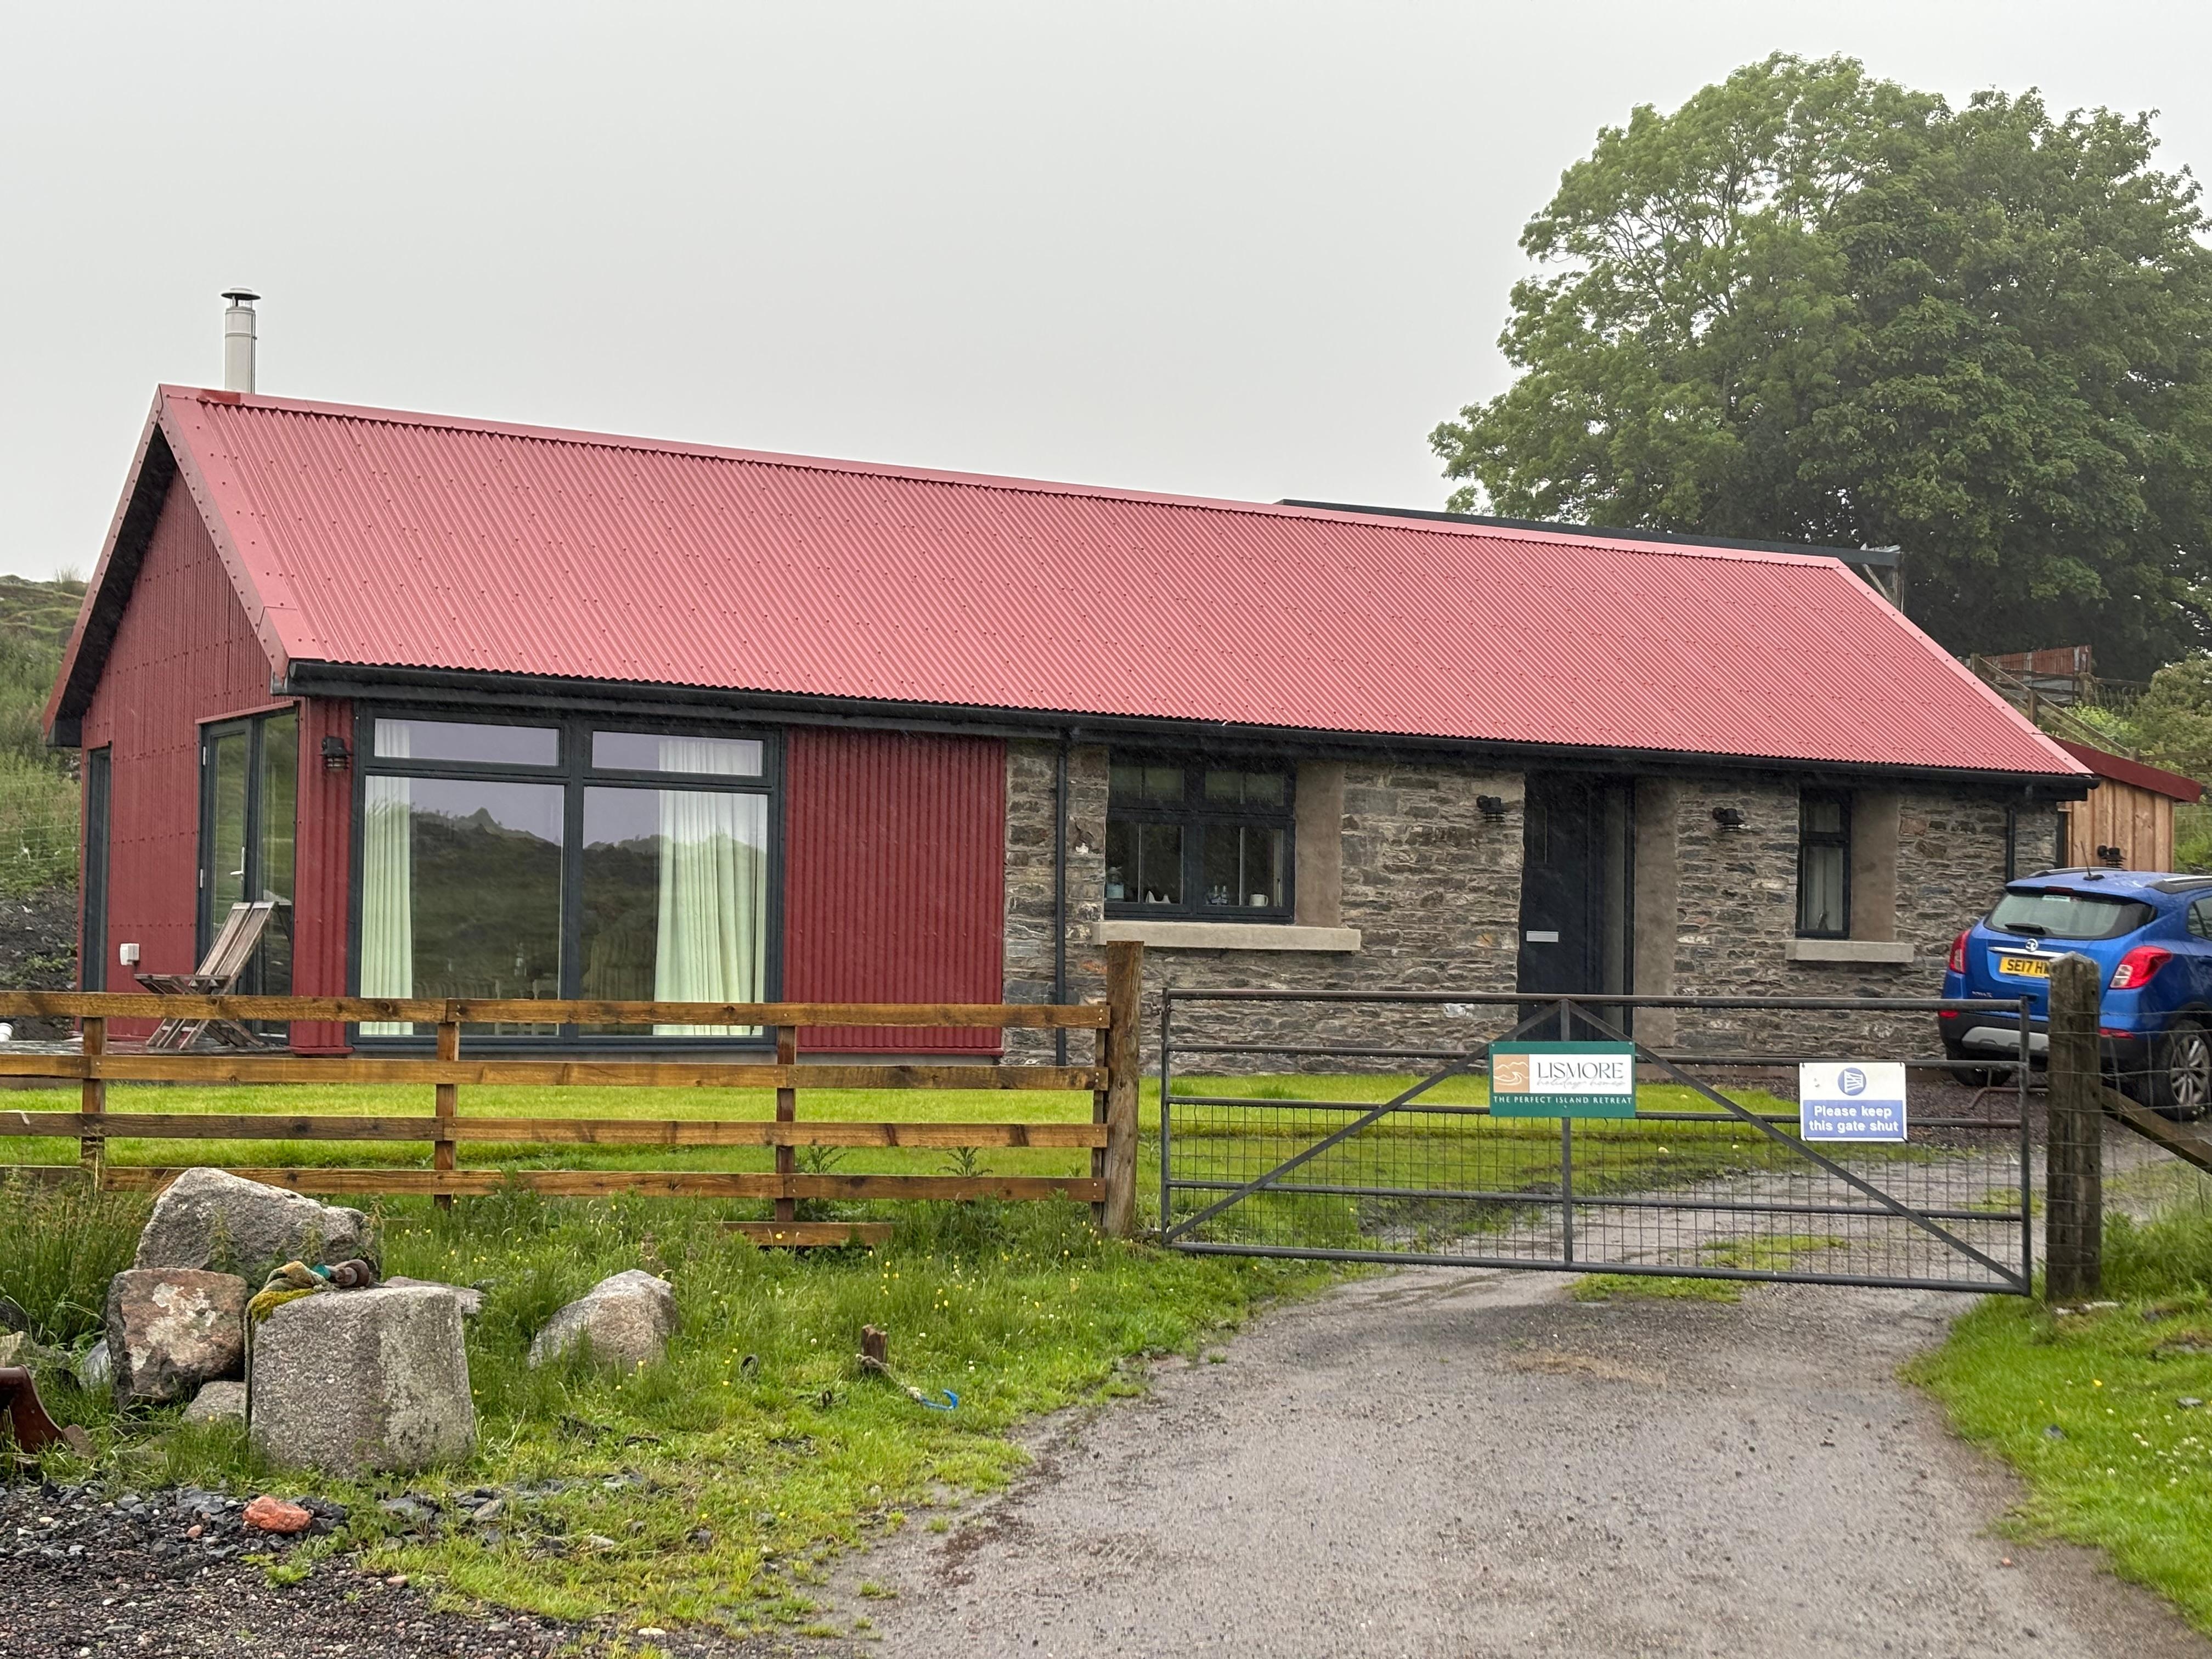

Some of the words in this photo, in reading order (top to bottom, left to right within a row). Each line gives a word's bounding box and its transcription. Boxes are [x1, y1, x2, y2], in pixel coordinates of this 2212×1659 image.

[2007, 959, 2033, 973] SE17
[1538, 1062, 1623, 1079] LISMORE
[1814, 1105, 1857, 1116] Please
[1861, 1105, 1892, 1119] keep
[1809, 1120, 1833, 1131] this
[1837, 1121, 1866, 1133] gate
[1870, 1120, 1899, 1132] shut
